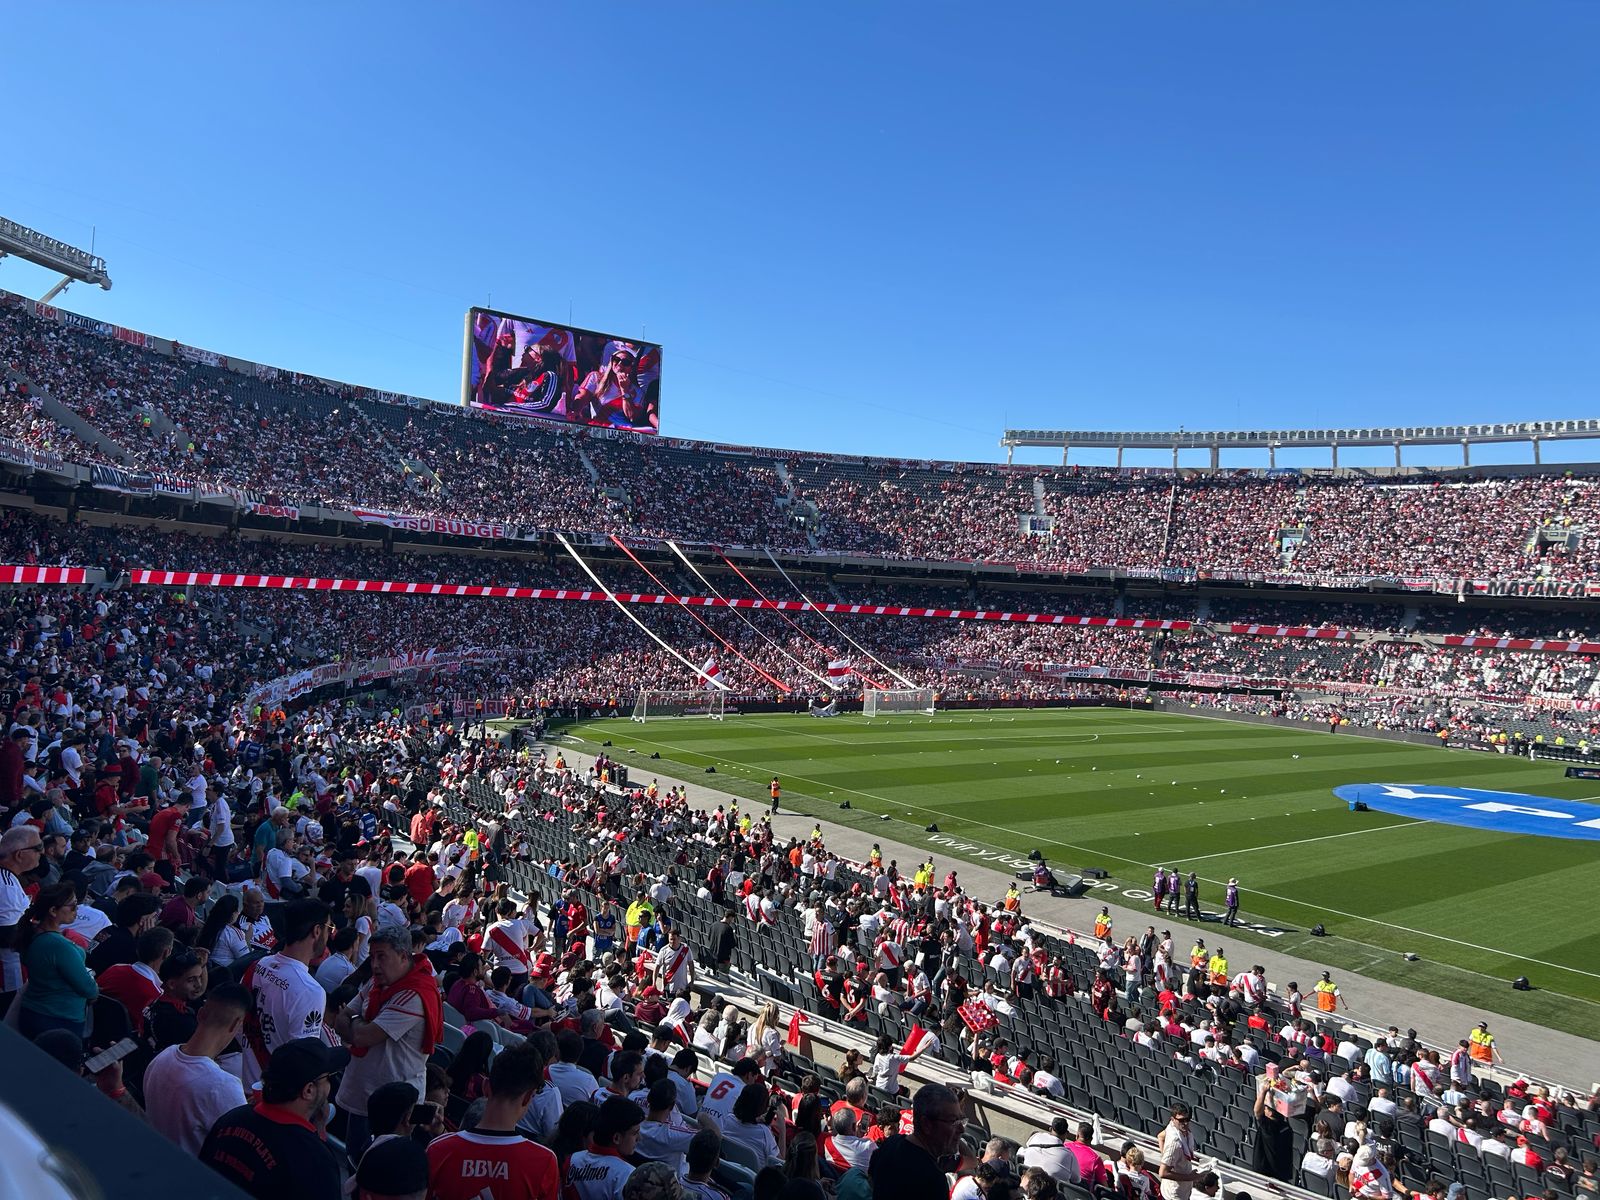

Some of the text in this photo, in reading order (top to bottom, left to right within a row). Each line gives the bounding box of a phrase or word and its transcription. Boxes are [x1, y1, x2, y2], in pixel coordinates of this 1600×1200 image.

[65, 312, 101, 332] TIZIANO
[434, 519, 502, 538] BUDGE
[1487, 581, 1586, 597] MATANZA
[1, 692, 11, 705] 23
[710, 1080, 735, 1101] 6
[461, 1159, 509, 1180] BBVA
[566, 1165, 611, 1185] Quilmes
